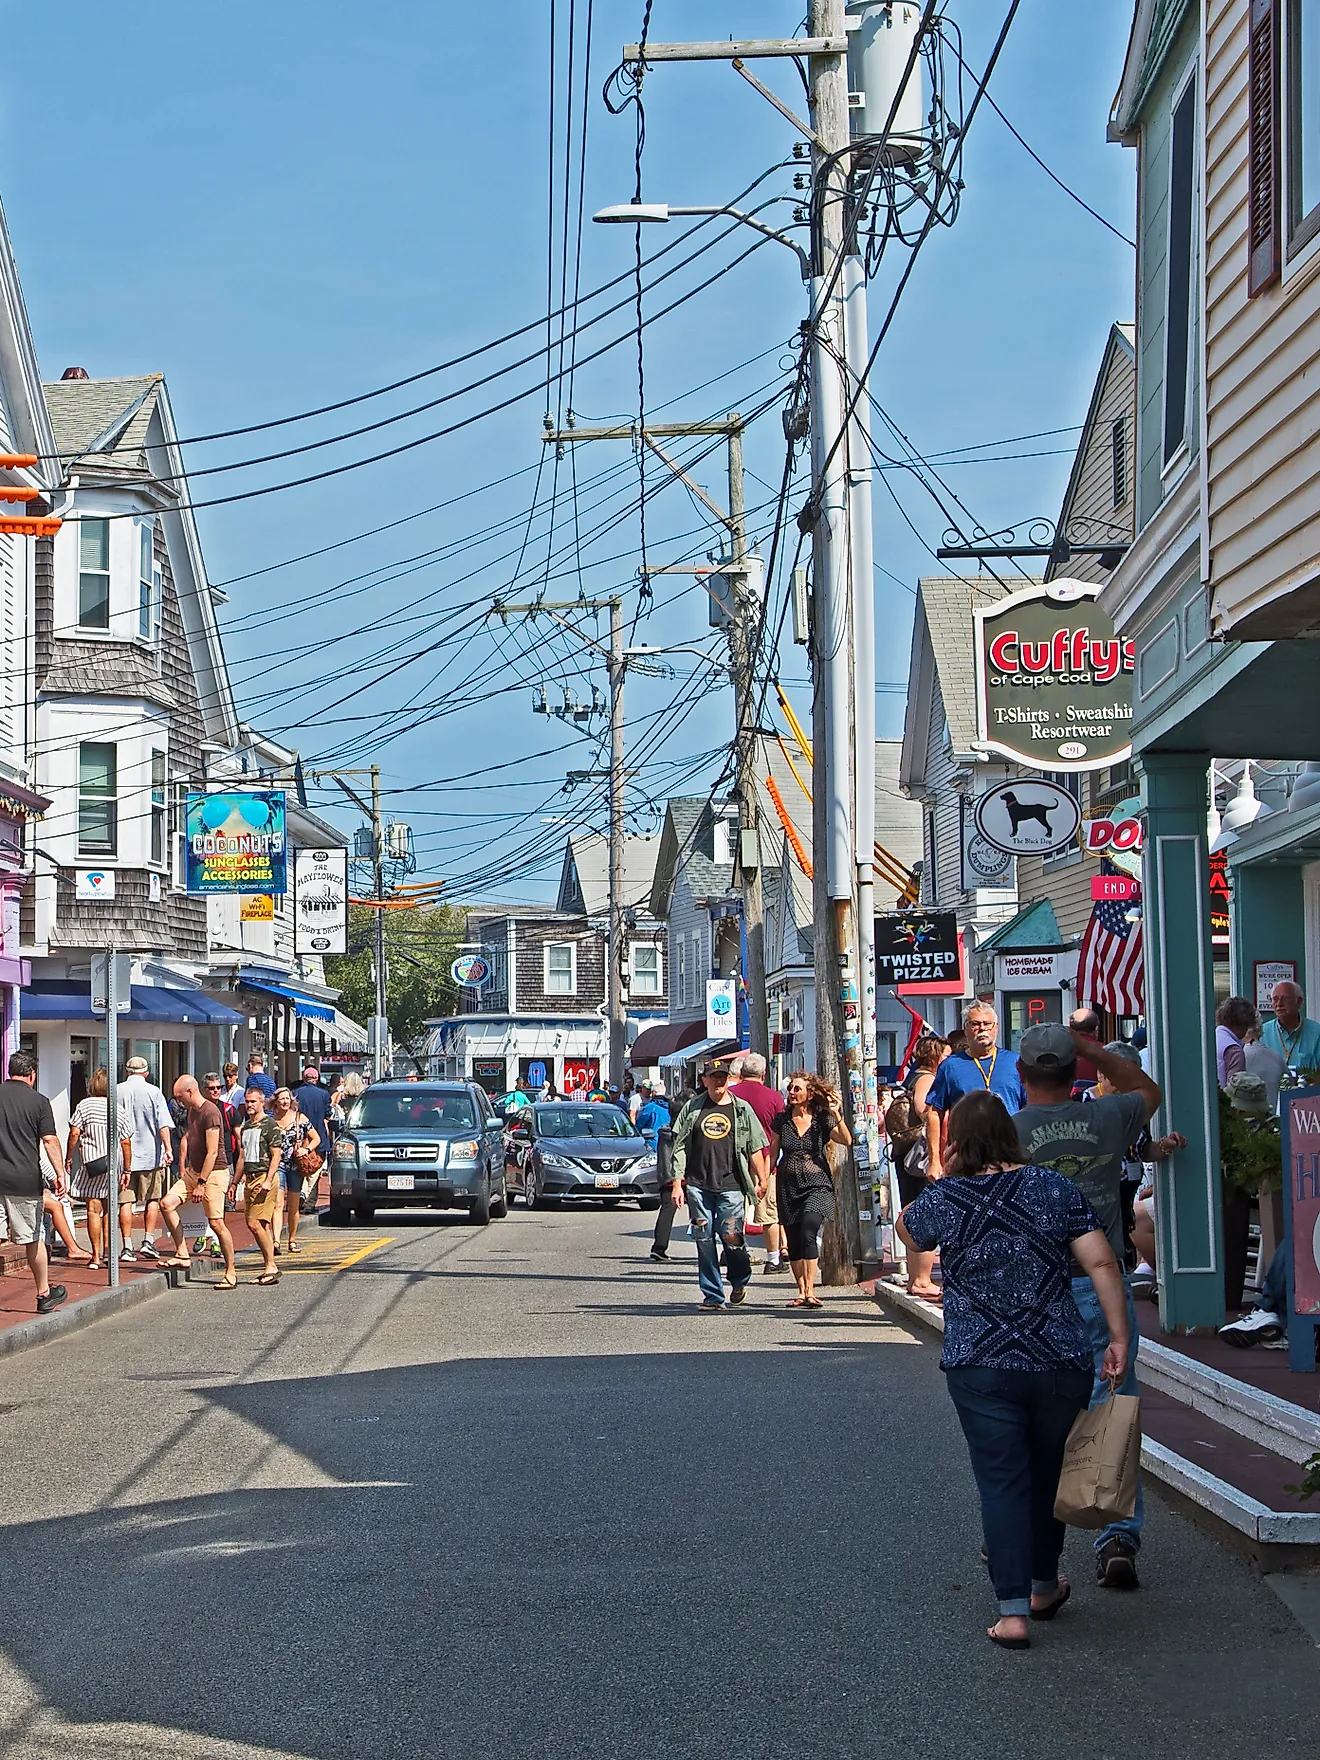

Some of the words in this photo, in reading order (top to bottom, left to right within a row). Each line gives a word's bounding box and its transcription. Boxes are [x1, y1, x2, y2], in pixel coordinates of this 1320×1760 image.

[991, 674, 1008, 685] of
[1012, 673, 1055, 687] Cape
[1059, 672, 1091, 683] Cod
[994, 706, 1051, 724] T-Shirts
[1030, 723, 1112, 740] Resortwear
[1065, 745, 1080, 755] 291
[192, 831, 284, 855] COCONUTS
[1040, 837, 1052, 845] Dog
[204, 856, 271, 869] SUNGLASSES
[971, 852, 1008, 873] DUMPLINGS
[201, 869, 273, 881] ACCESSORIES
[297, 873, 344, 887] MAYFLOWER
[1104, 882, 1126, 894] END
[241, 910, 273, 918] FIREPLACE
[880, 952, 956, 967] TWISTED
[1005, 956, 1053, 966] HOMEMADE
[893, 966, 945, 981] PIZZA
[1021, 965, 1052, 976] CREAM
[712, 998, 731, 1009] Art
[710, 1017, 733, 1026] Tiles
[714, 1061, 721, 1069] P
[1031, 1120, 1089, 1138] SEACOAST
